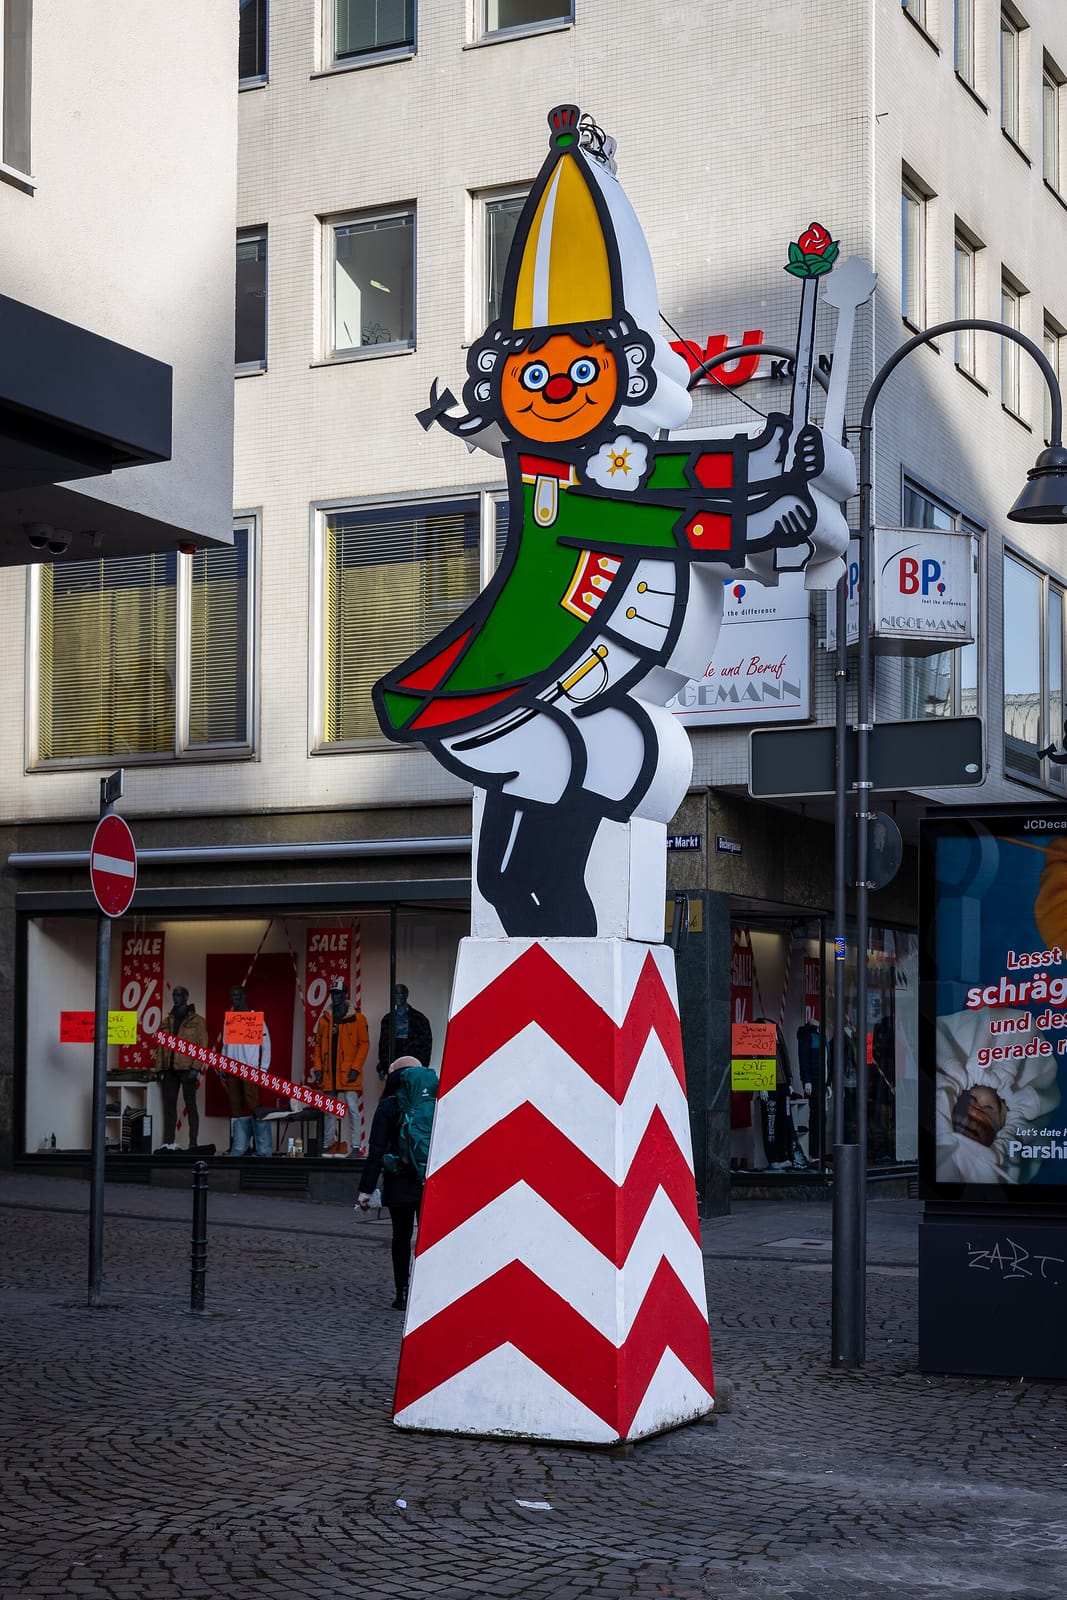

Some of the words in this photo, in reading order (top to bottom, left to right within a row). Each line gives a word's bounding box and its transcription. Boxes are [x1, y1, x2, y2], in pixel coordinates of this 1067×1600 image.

[727, 609, 738, 617] the
[741, 607, 777, 616] difference
[721, 658, 744, 677] und
[746, 654, 788, 680] Beruf
[675, 836, 699, 848] Markt
[124, 938, 162, 956] SALE
[309, 934, 349, 952] SALE
[1007, 947, 1062, 970] Lasst
[966, 972, 1067, 1010] schräg
[989, 1011, 1031, 1036] und
[747, 1038, 774, 1051] -20%
[977, 1037, 1052, 1069] gerade
[1016, 1127, 1038, 1137] Let's
[1039, 1127, 1062, 1137] date
[1009, 1140, 1067, 1160] Parshi
